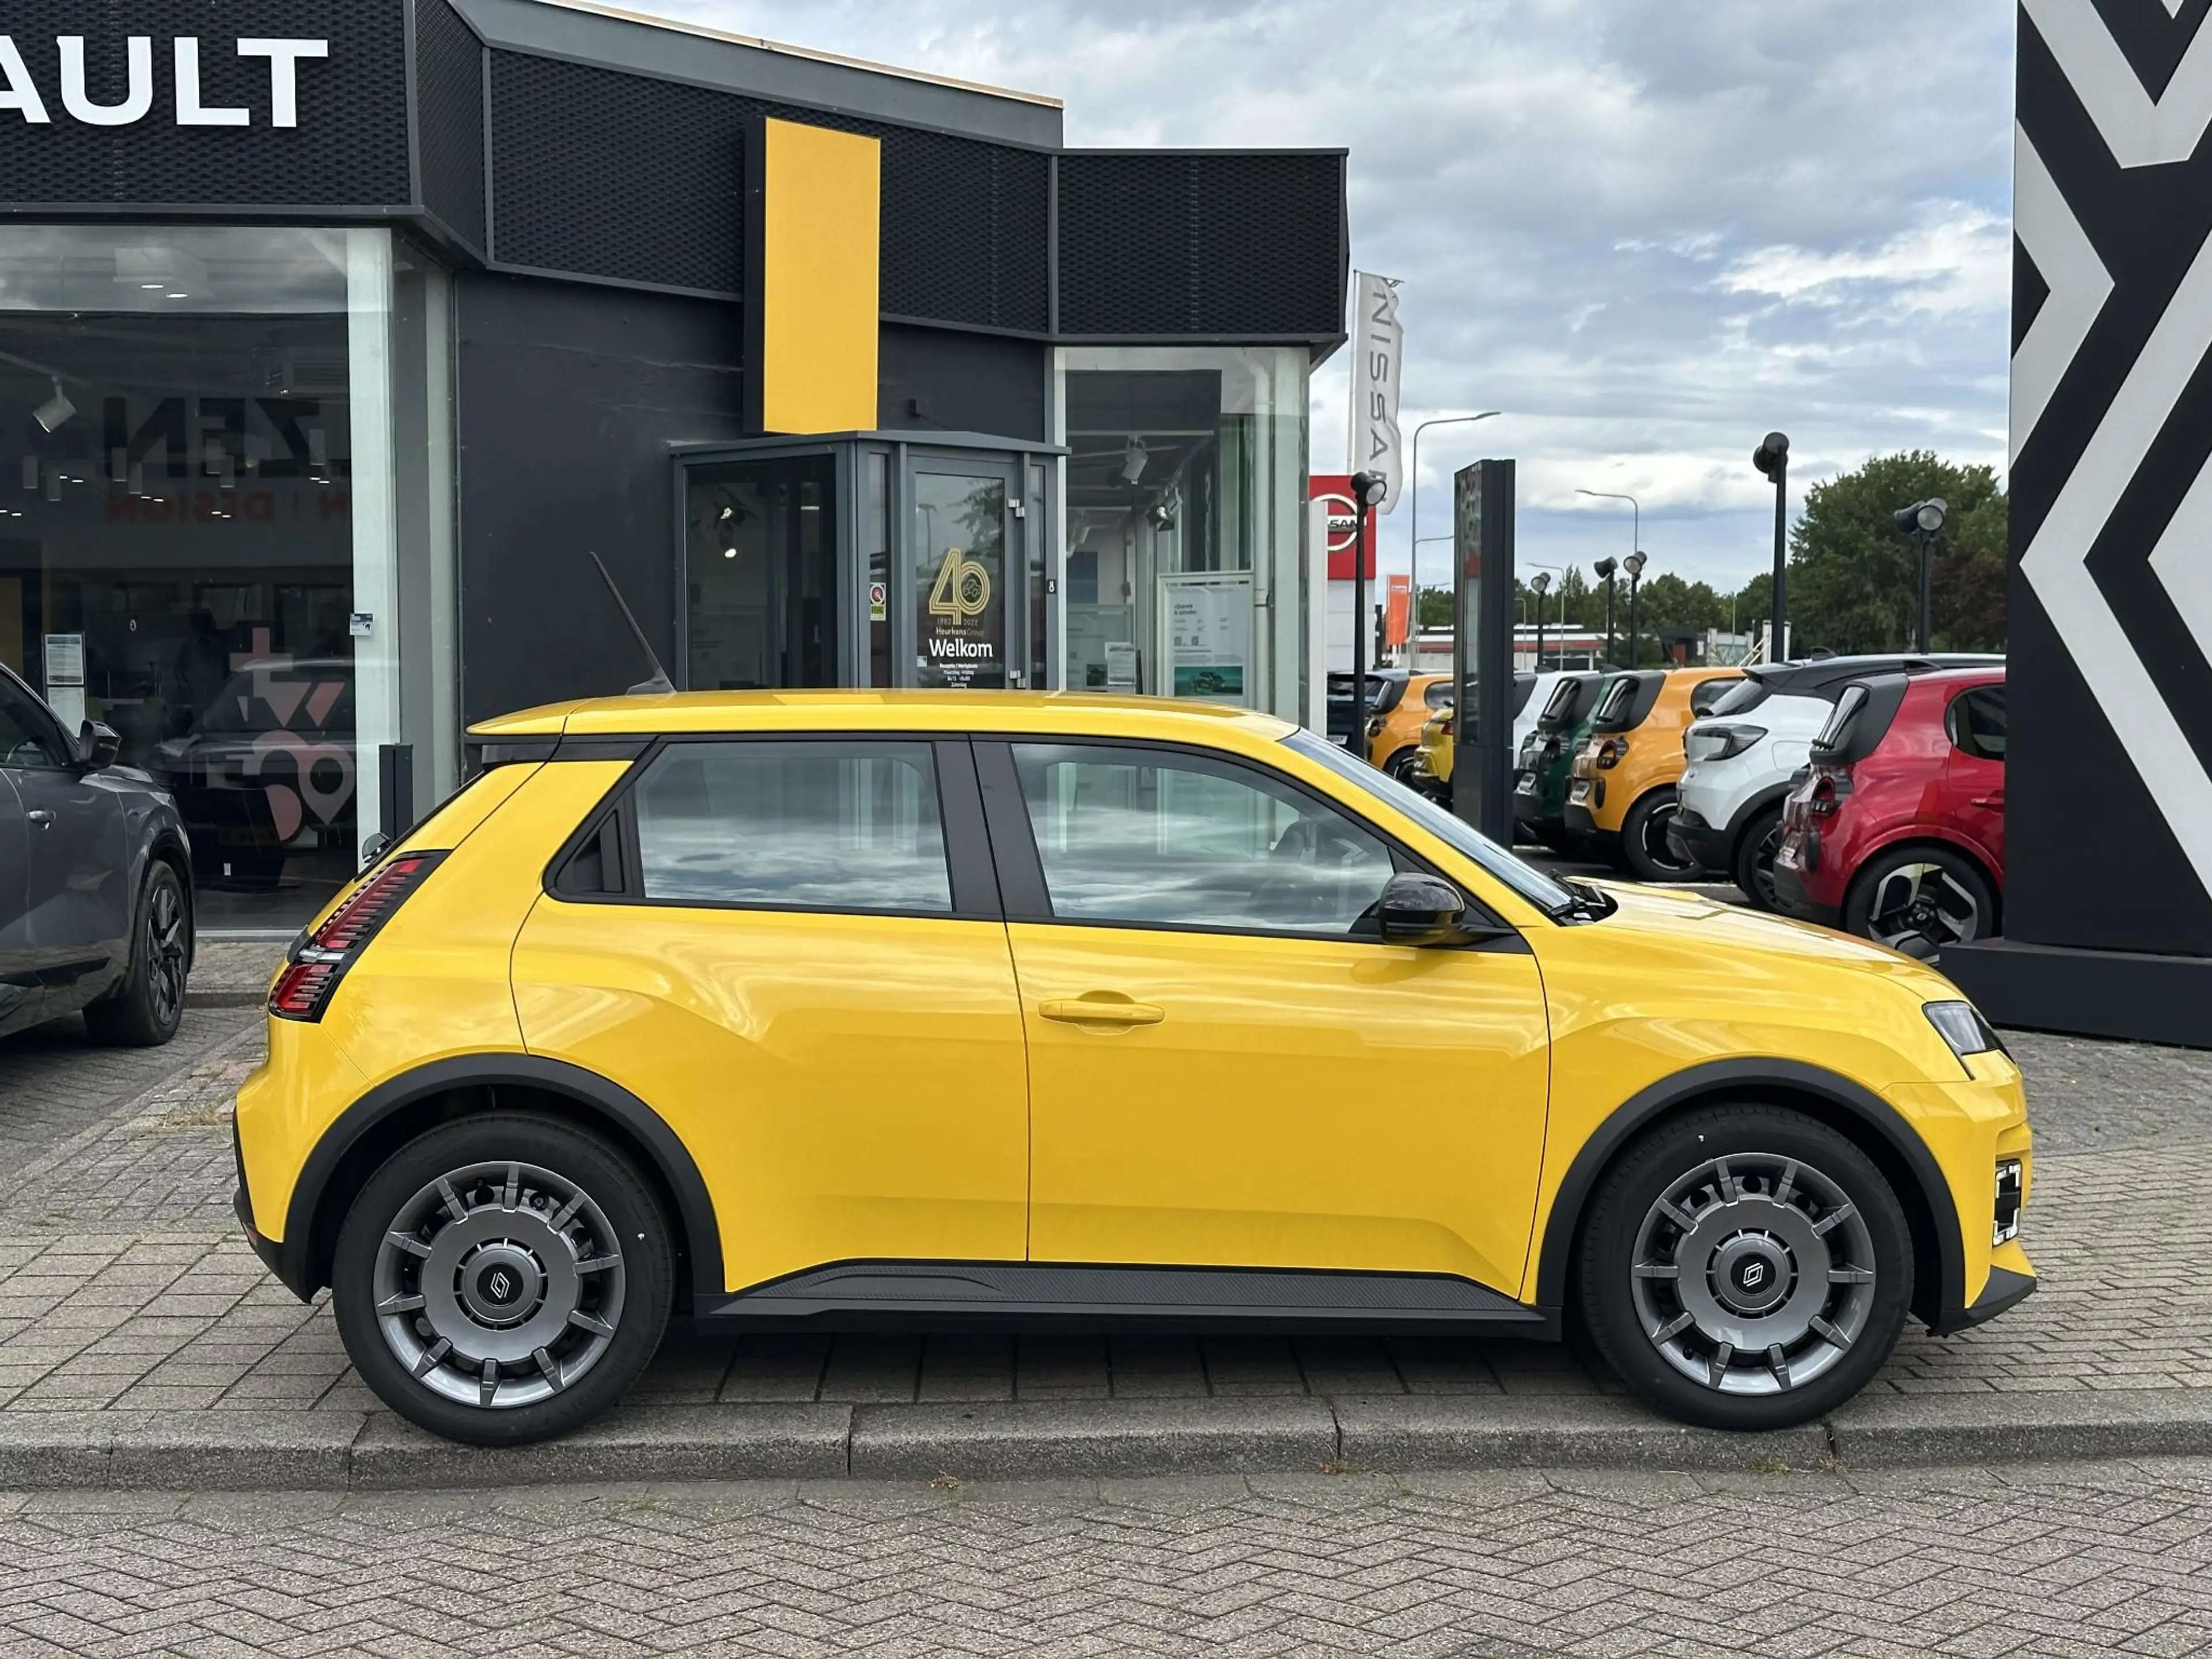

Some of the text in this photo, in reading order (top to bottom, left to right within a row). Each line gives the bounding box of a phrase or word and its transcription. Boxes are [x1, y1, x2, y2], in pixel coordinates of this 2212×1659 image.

[1328, 520, 1357, 528] SAN
[929, 548, 990, 625] 40
[1048, 580, 1055, 593] 8
[929, 638, 993, 657] Welkom
